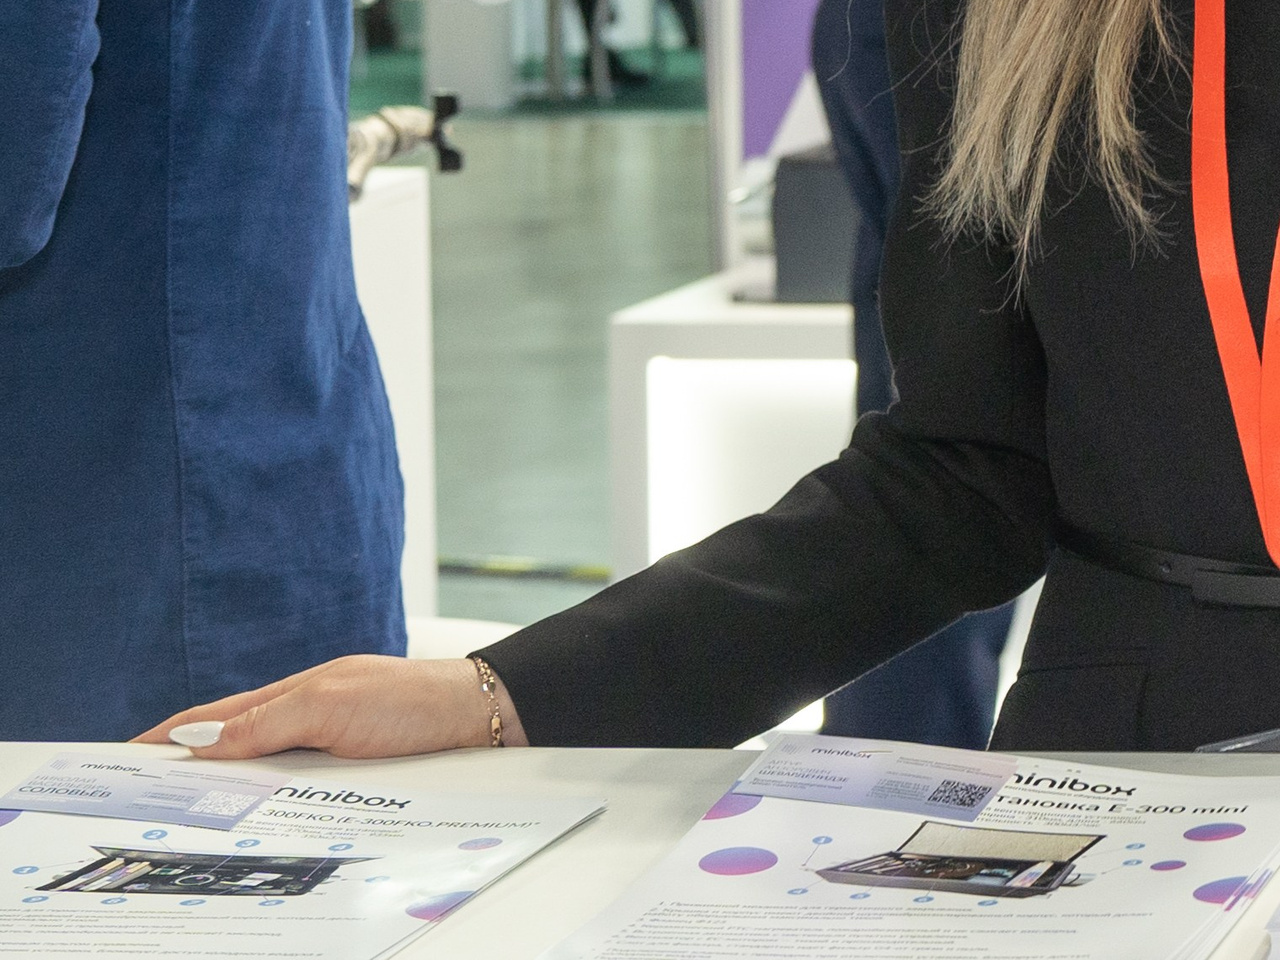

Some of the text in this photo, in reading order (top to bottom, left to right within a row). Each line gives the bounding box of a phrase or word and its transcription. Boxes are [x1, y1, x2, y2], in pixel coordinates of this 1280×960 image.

[810, 748, 873, 759] minibox
[80, 762, 142, 773] minibox
[995, 794, 1101, 812] тановка
[1108, 803, 1186, 814] E-300
[1191, 805, 1249, 814] mini
[251, 809, 335, 823] -300FKO
